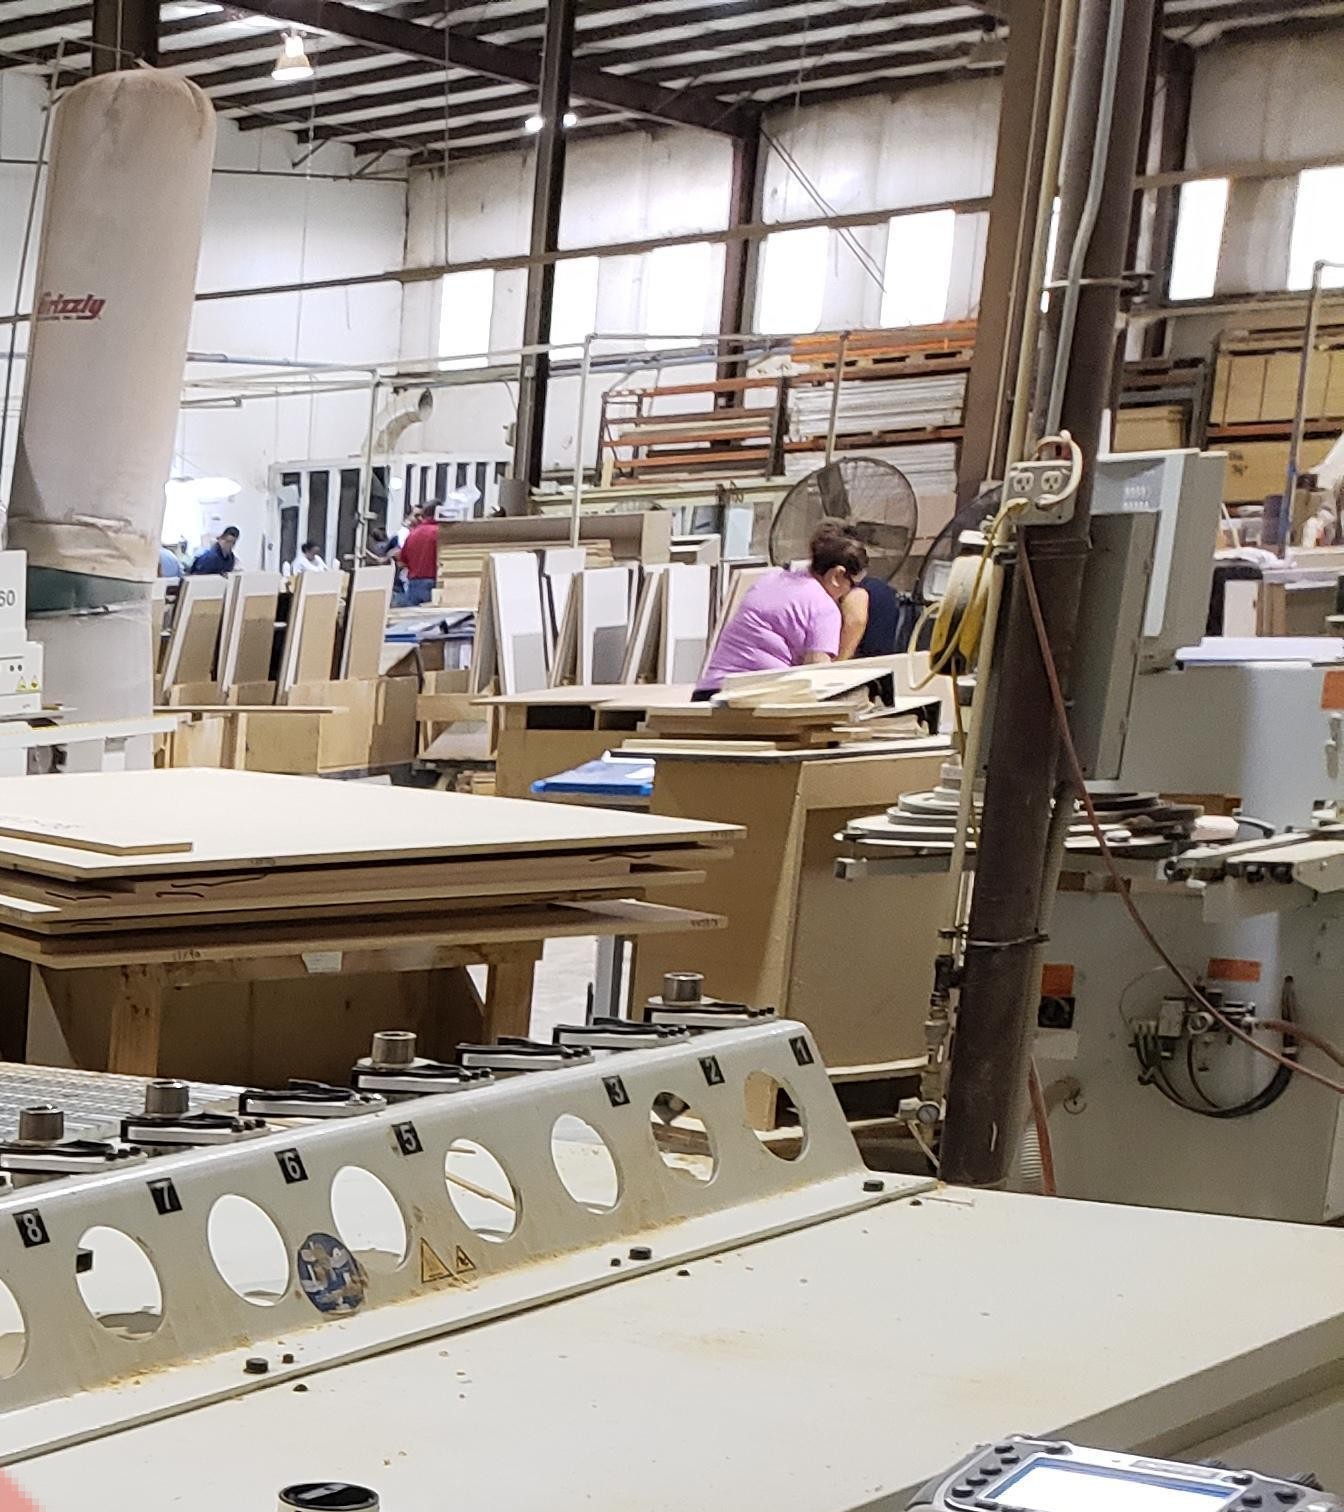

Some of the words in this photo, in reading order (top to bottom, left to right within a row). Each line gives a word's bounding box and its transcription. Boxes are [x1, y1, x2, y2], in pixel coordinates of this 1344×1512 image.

[23, 1212, 43, 1243] 8
[149, 1180, 173, 1211] 7
[282, 1152, 302, 1180] 6
[399, 1124, 417, 1151] 5
[605, 1077, 625, 1103] 3
[704, 1058, 721, 1083] 2
[795, 1038, 810, 1064] 1
